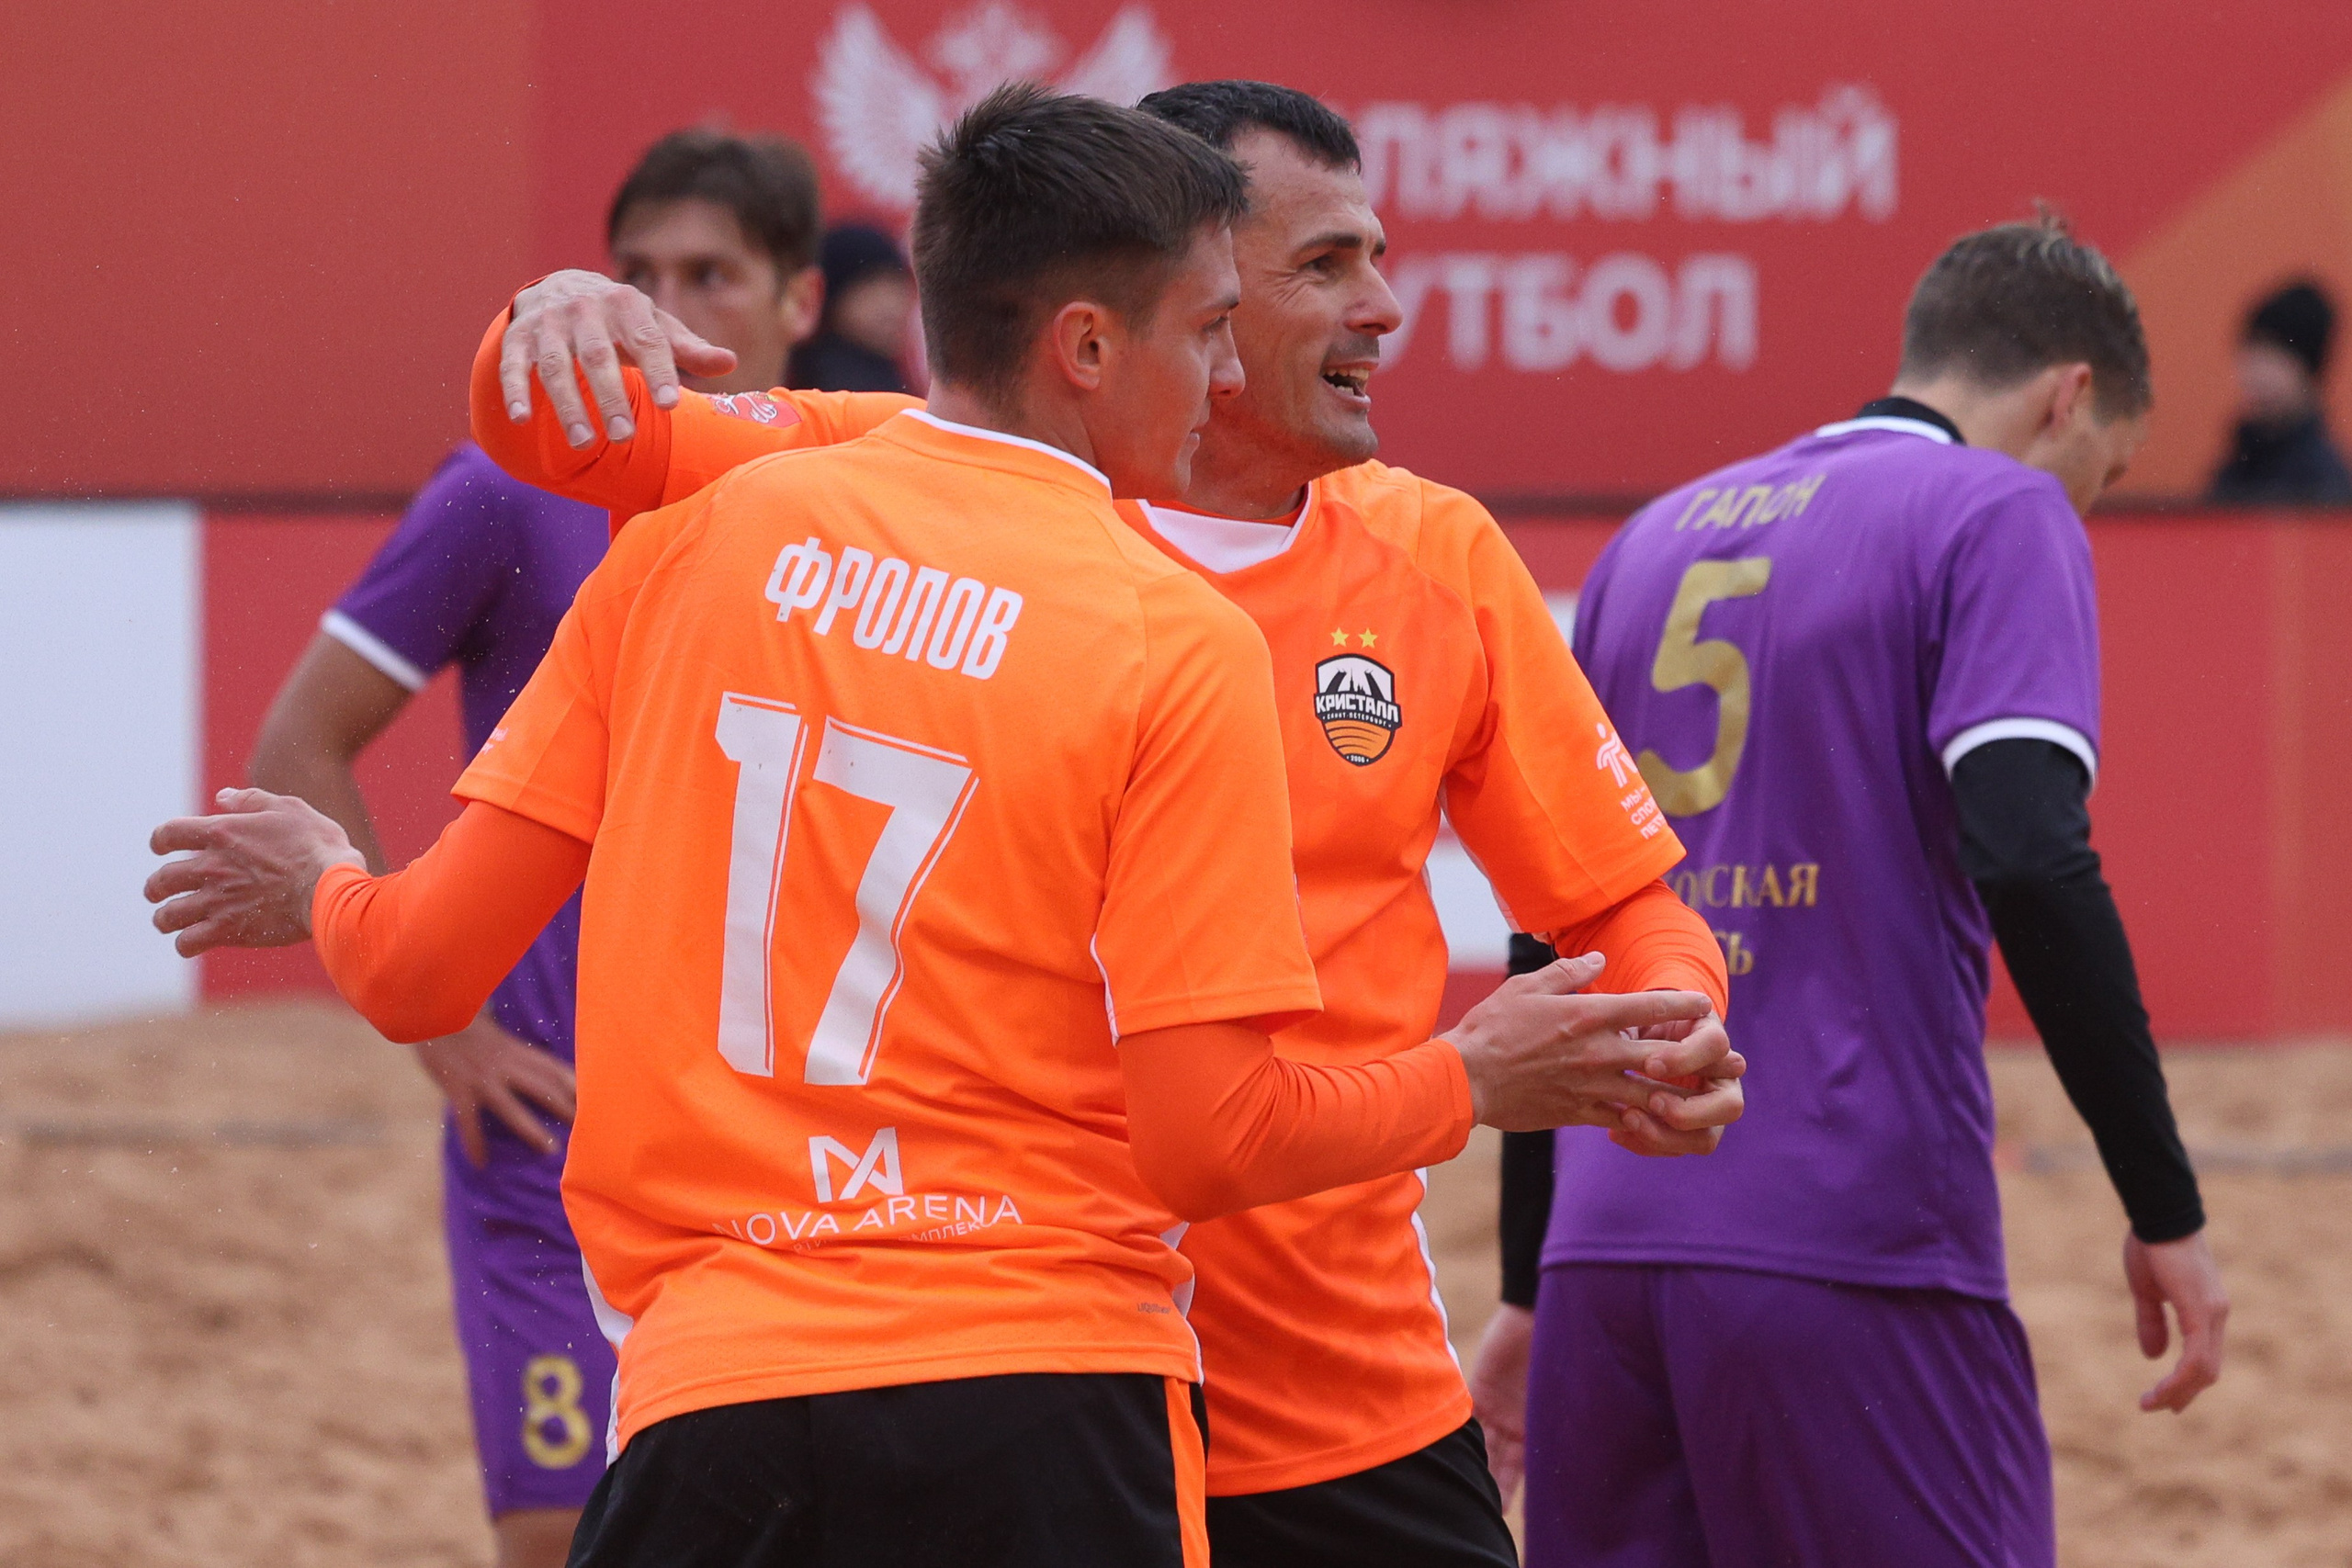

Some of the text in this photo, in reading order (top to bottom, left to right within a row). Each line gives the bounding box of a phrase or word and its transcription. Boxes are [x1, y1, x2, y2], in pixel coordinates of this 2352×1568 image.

[1356, 85, 1898, 222] ЛЯЖНЫЙ
[1378, 251, 1761, 371] УТБОЛ
[1675, 472, 1827, 533] ГАПОН
[763, 536, 1024, 681] ФРОЛОВ
[1316, 693, 1399, 724] КРИСТАЛЛ
[1636, 557, 1772, 818] 5
[714, 692, 979, 1087] 17
[712, 1194, 1023, 1246] NOVA ARENA
[521, 1352, 594, 1470] 8
